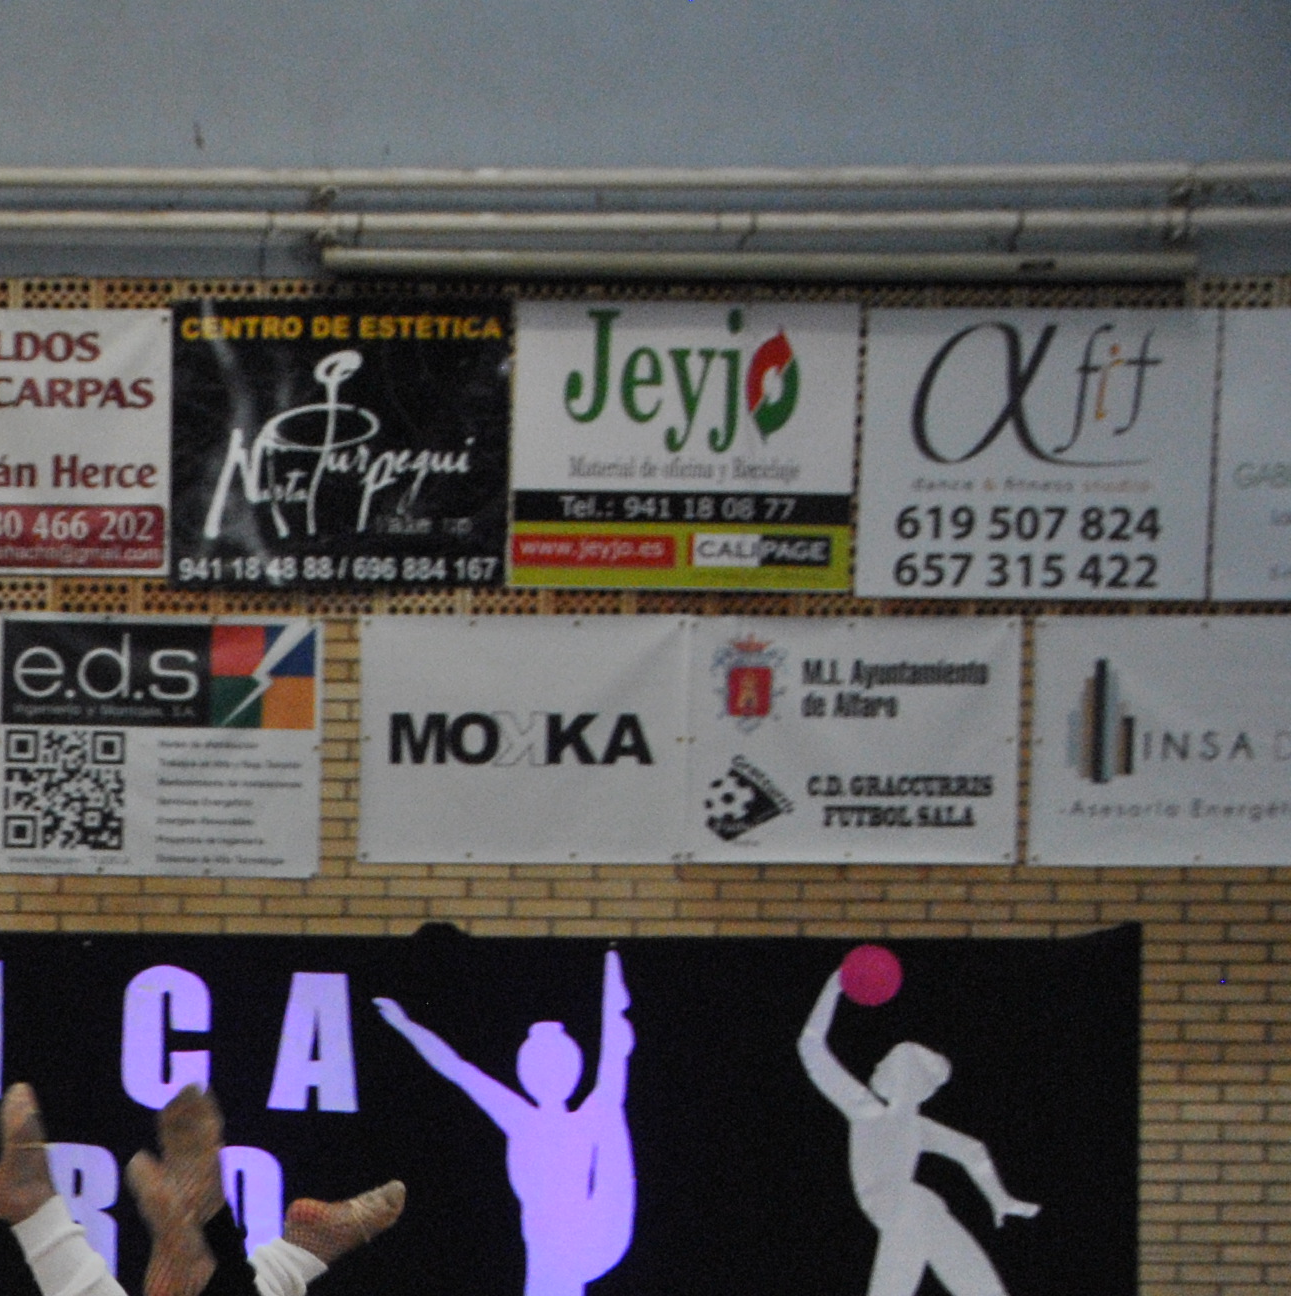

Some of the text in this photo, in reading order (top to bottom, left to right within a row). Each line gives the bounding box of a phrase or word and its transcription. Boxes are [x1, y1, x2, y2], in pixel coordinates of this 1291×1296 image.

[180, 316, 304, 339] CENTRO
[311, 316, 351, 339] DE
[52, 454, 157, 488] Herce
[623, 496, 672, 518] 941
[683, 497, 714, 519] 18
[766, 498, 797, 520] 77
[32, 510, 90, 540] 466
[99, 511, 155, 541] 202
[895, 505, 1161, 541] 619 507 824
[520, 541, 664, 560] www.jeyjo.es
[178, 557, 221, 582] 941
[232, 558, 262, 582] 18
[303, 557, 333, 580] 88
[454, 557, 498, 579] 167
[893, 553, 1157, 588] 657 315 422
[13, 632, 199, 701] e.d.s
[850, 660, 990, 688] Ayuntamiento
[801, 692, 899, 718] de Alfaro
[1142, 730, 1255, 762] INSA
[823, 805, 975, 827] FUTBOL SALA
